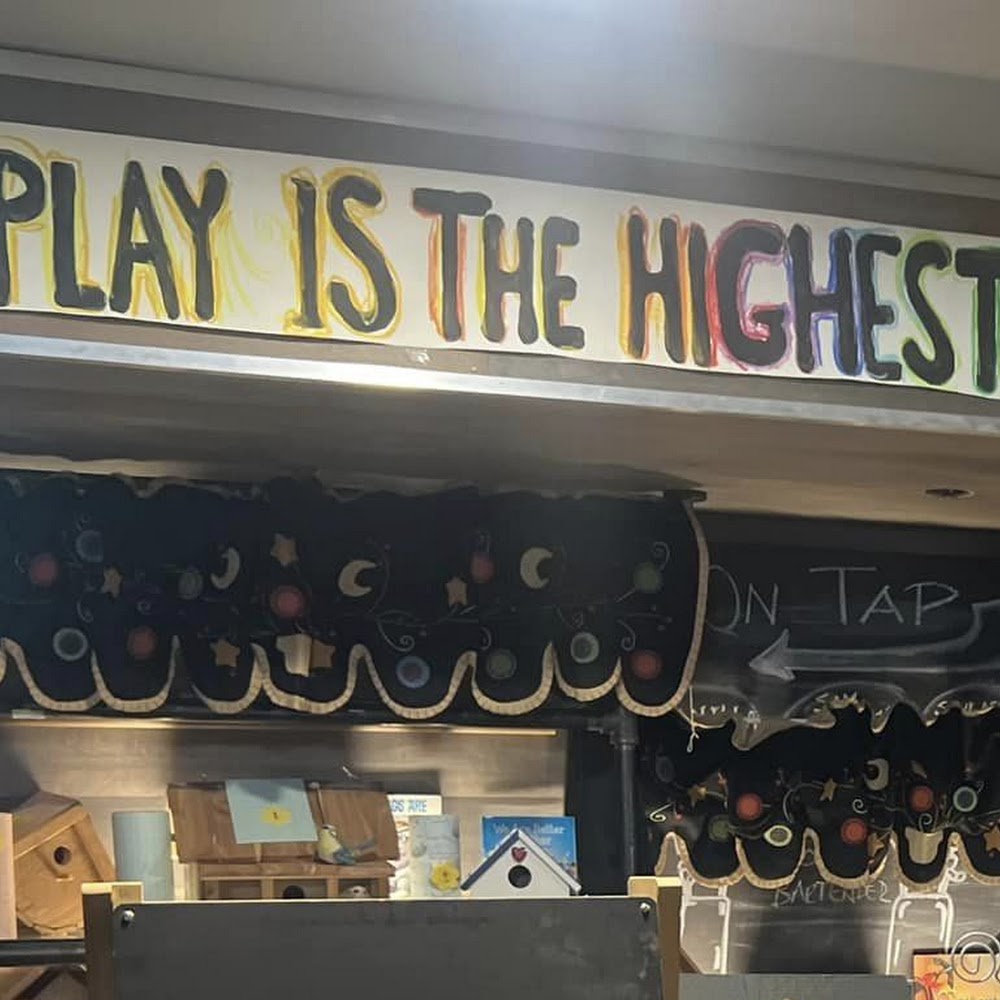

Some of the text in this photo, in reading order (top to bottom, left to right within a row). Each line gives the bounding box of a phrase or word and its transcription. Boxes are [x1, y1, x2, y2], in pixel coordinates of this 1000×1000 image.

[0, 148, 228, 321] PLAY
[286, 170, 399, 335] IS
[411, 187, 586, 349] THE
[809, 566, 959, 625] TAP
